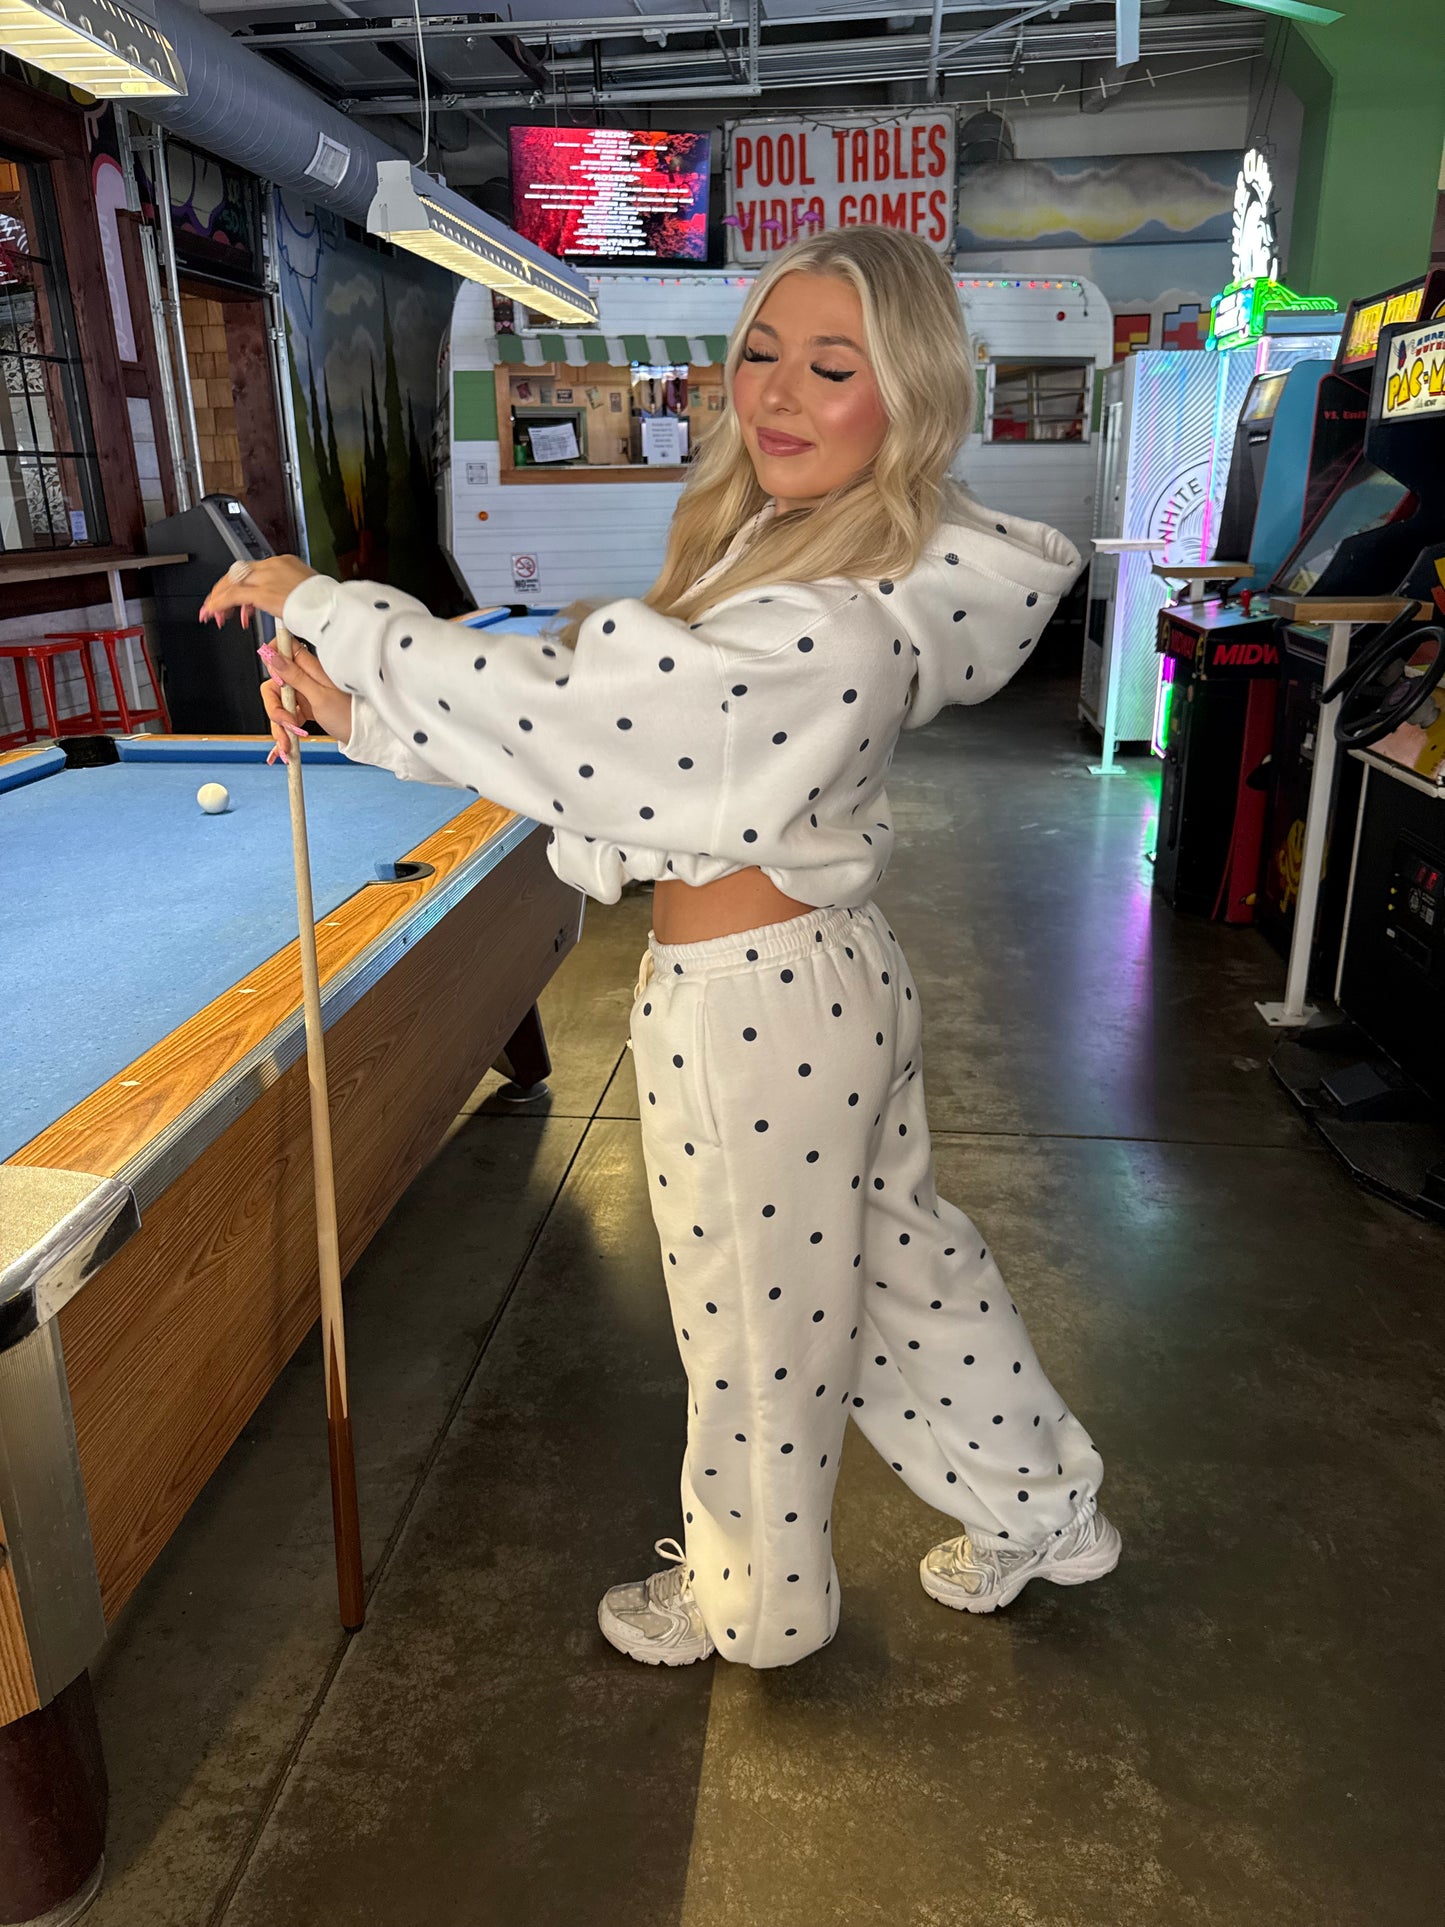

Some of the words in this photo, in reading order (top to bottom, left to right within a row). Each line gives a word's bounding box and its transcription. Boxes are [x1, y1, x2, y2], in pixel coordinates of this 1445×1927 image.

[735, 133, 815, 189] POOL
[831, 124, 947, 184] TABLES
[736, 196, 825, 252] VIDEO
[839, 189, 947, 243] GAMES
[1387, 357, 1445, 412] PAC-M
